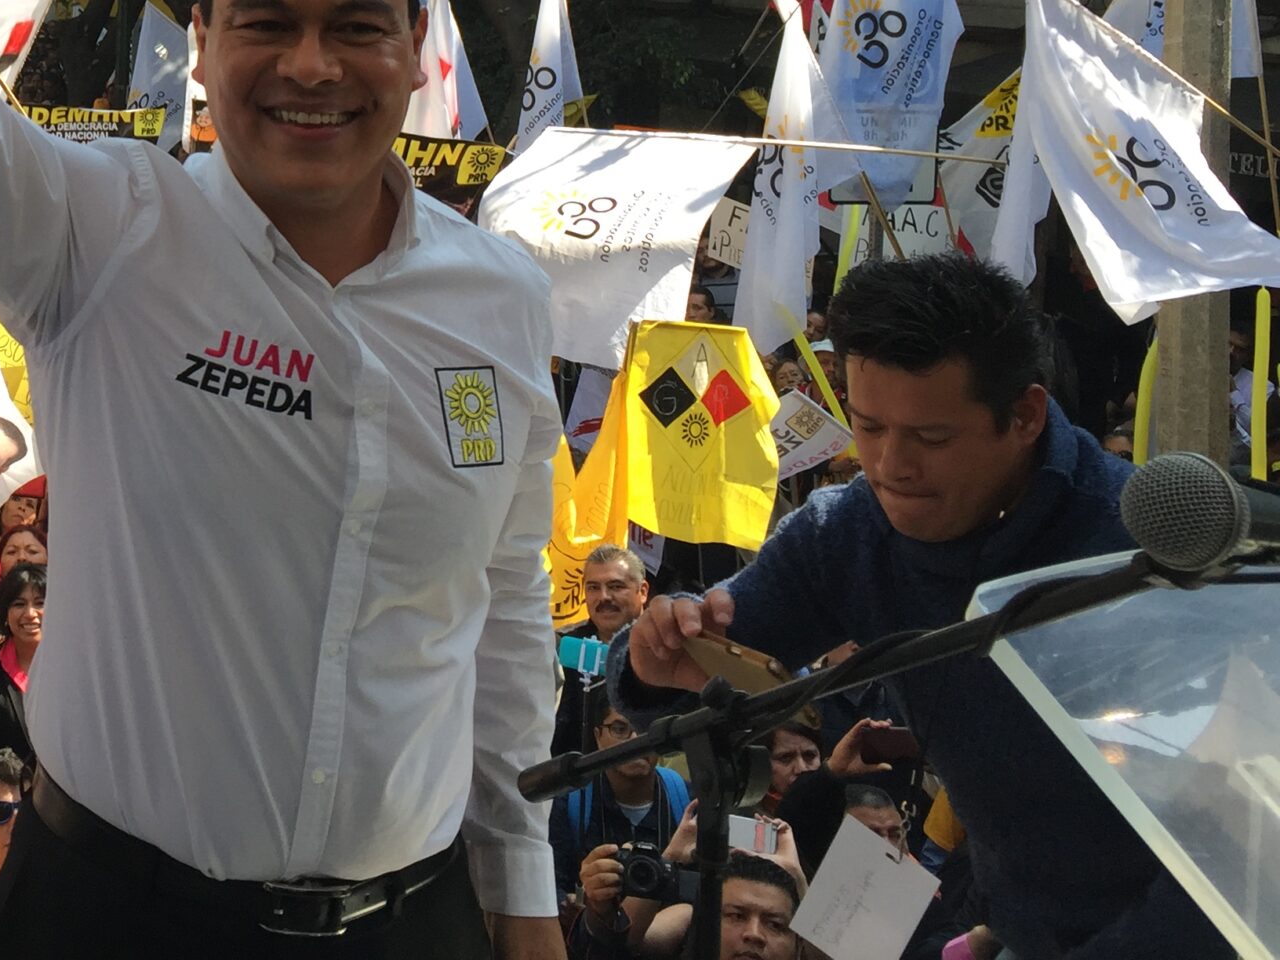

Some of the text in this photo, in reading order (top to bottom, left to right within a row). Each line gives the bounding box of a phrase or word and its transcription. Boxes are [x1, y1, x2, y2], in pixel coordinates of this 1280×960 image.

[57, 122, 119, 132] DEMOCRACIA
[979, 114, 1016, 132] PR
[467, 172, 488, 184] PRD
[204, 329, 315, 383] JUAN
[175, 352, 313, 421] ZEPEDA
[460, 438, 496, 462] PRD
